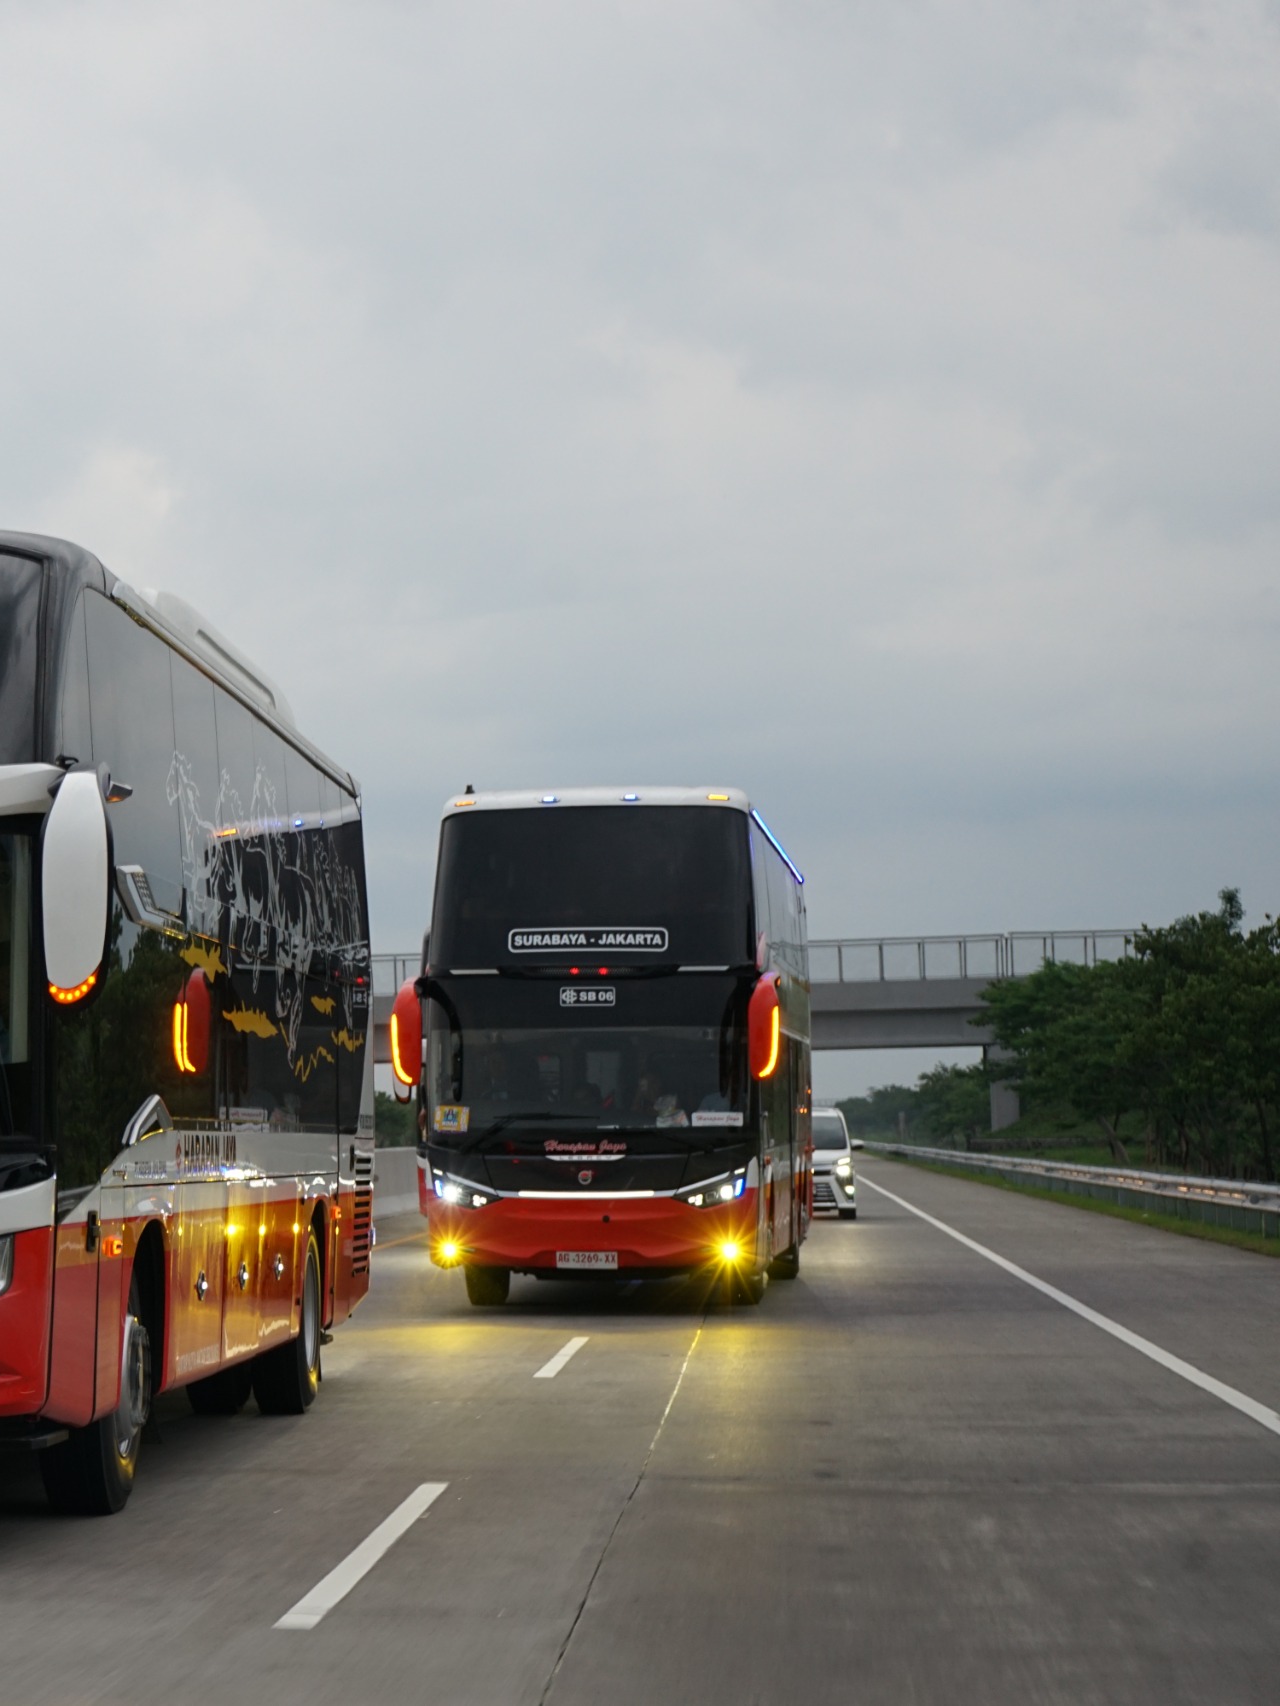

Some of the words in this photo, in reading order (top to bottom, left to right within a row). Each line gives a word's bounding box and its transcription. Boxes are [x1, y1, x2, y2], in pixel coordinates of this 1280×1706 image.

[514, 934, 587, 947] SURABAYA
[598, 934, 662, 946] JAKARTA
[579, 991, 596, 1002] SB
[598, 991, 614, 1002] 06
